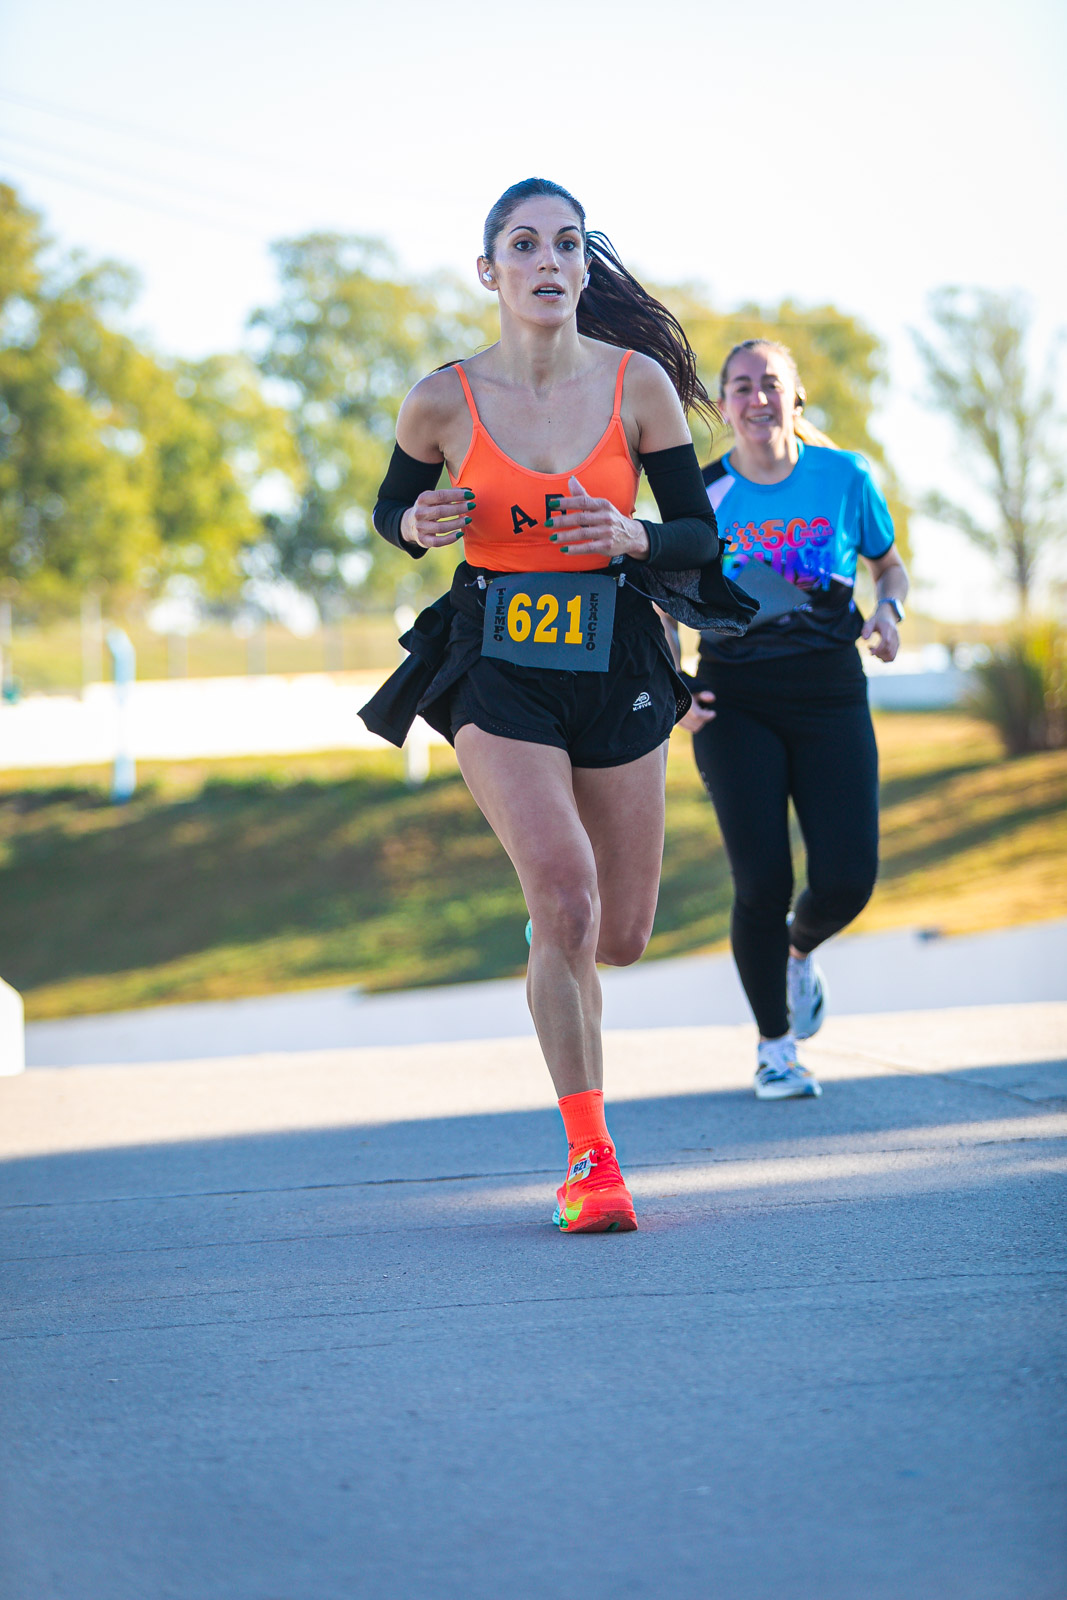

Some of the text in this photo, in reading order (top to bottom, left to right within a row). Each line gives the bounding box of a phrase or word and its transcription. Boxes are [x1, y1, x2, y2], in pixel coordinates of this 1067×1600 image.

[493, 588, 506, 642] TIEMPO
[507, 592, 583, 644] 621
[586, 593, 599, 651] EXACTO
[573, 1160, 588, 1172] 621
